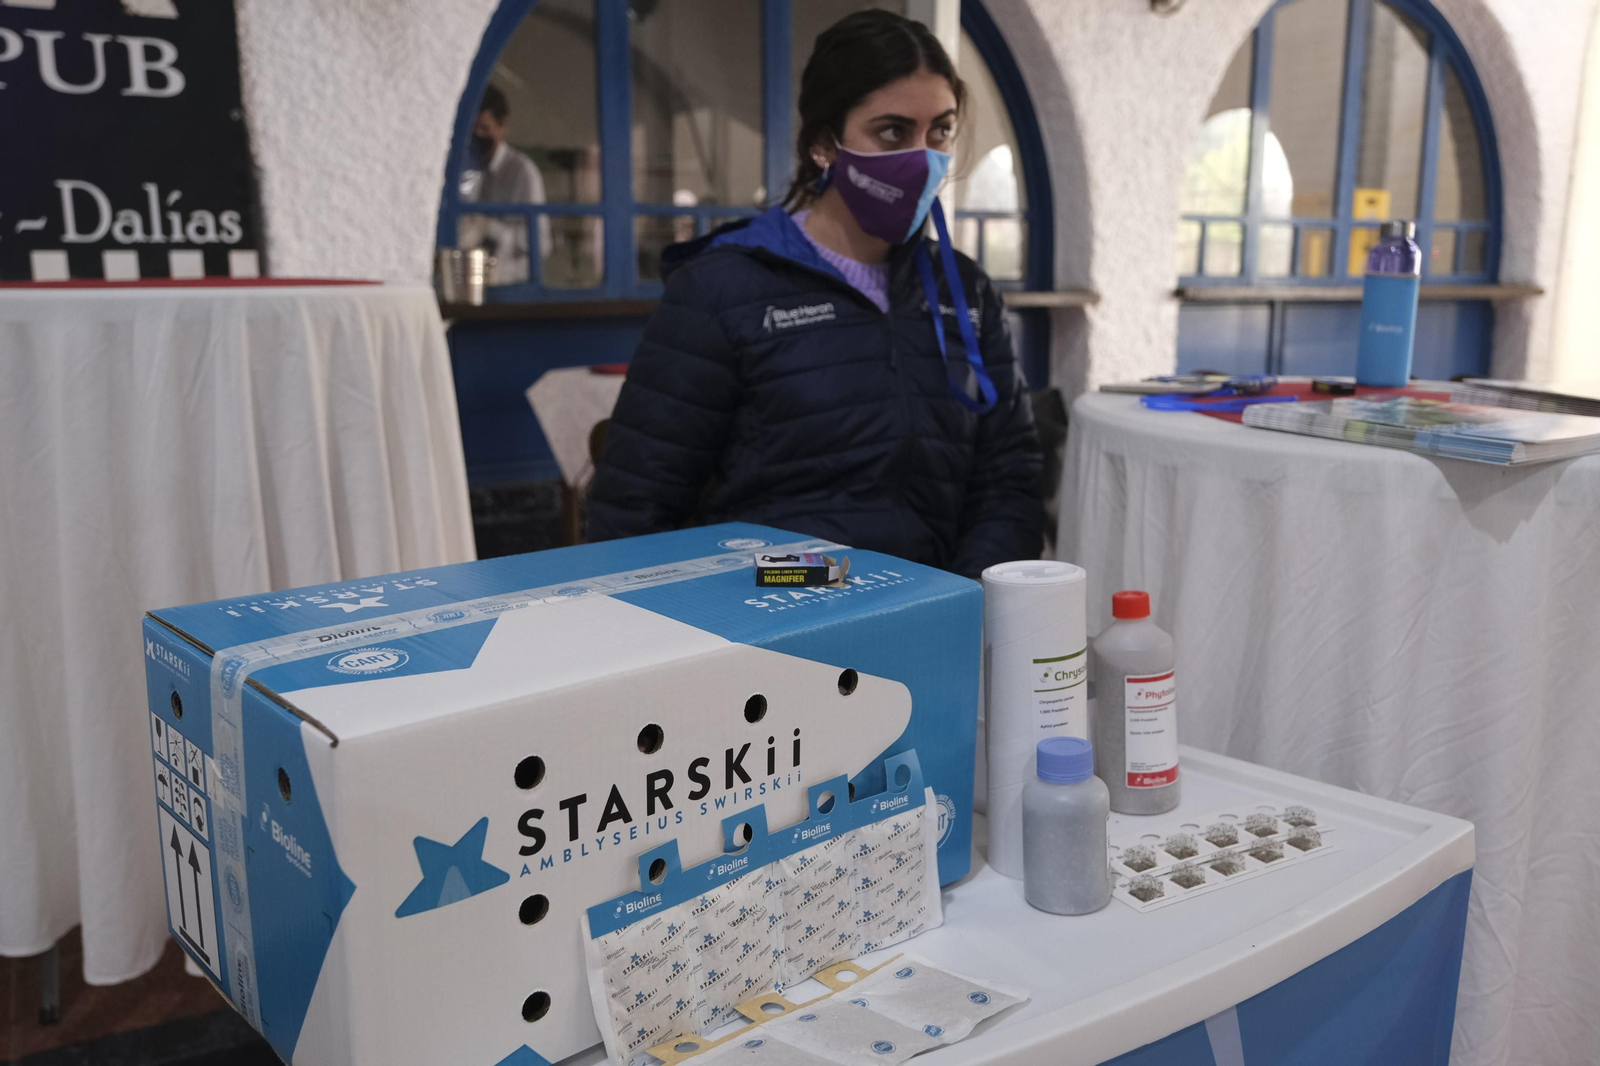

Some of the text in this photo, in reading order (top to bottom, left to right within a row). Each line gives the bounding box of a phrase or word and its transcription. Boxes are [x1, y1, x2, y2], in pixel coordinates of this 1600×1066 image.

[55, 178, 243, 244] Dalías
[764, 574, 805, 583] MAGNIFIER
[155, 643, 190, 677] STARSKii
[344, 653, 392, 669] CART
[517, 728, 801, 857] STARSKii
[880, 795, 909, 811] Bioline
[519, 770, 802, 878] AMBLYSEIUS SWIRSKii
[801, 822, 831, 840] Bioline
[271, 819, 312, 869] Bioline
[717, 856, 748, 876] Bioline
[626, 893, 662, 914] Bioline
